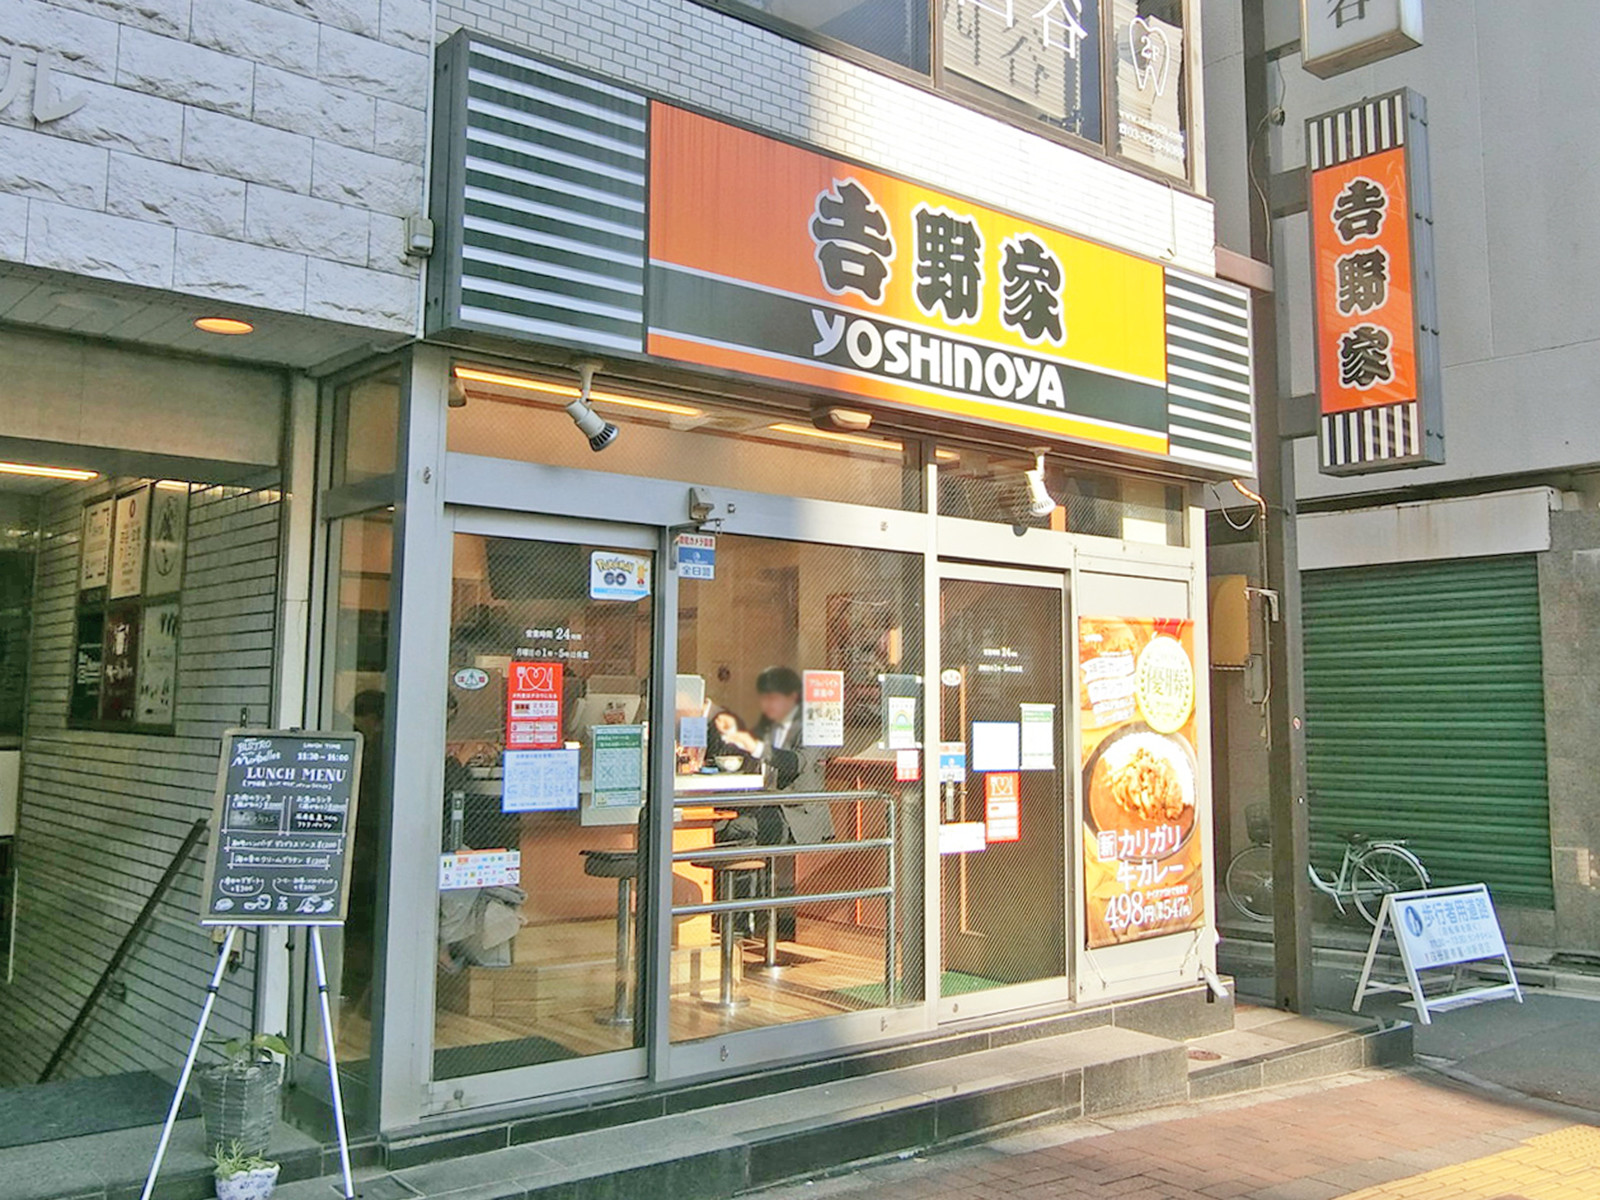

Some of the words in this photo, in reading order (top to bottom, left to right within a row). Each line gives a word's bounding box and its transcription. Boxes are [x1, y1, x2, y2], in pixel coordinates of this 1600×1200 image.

[603, 572, 627, 585] GO
[246, 767, 296, 780] LUNCH
[301, 768, 347, 782] MENU
[1118, 823, 1181, 857] カリガリ
[1117, 858, 1184, 891] 牛カレー
